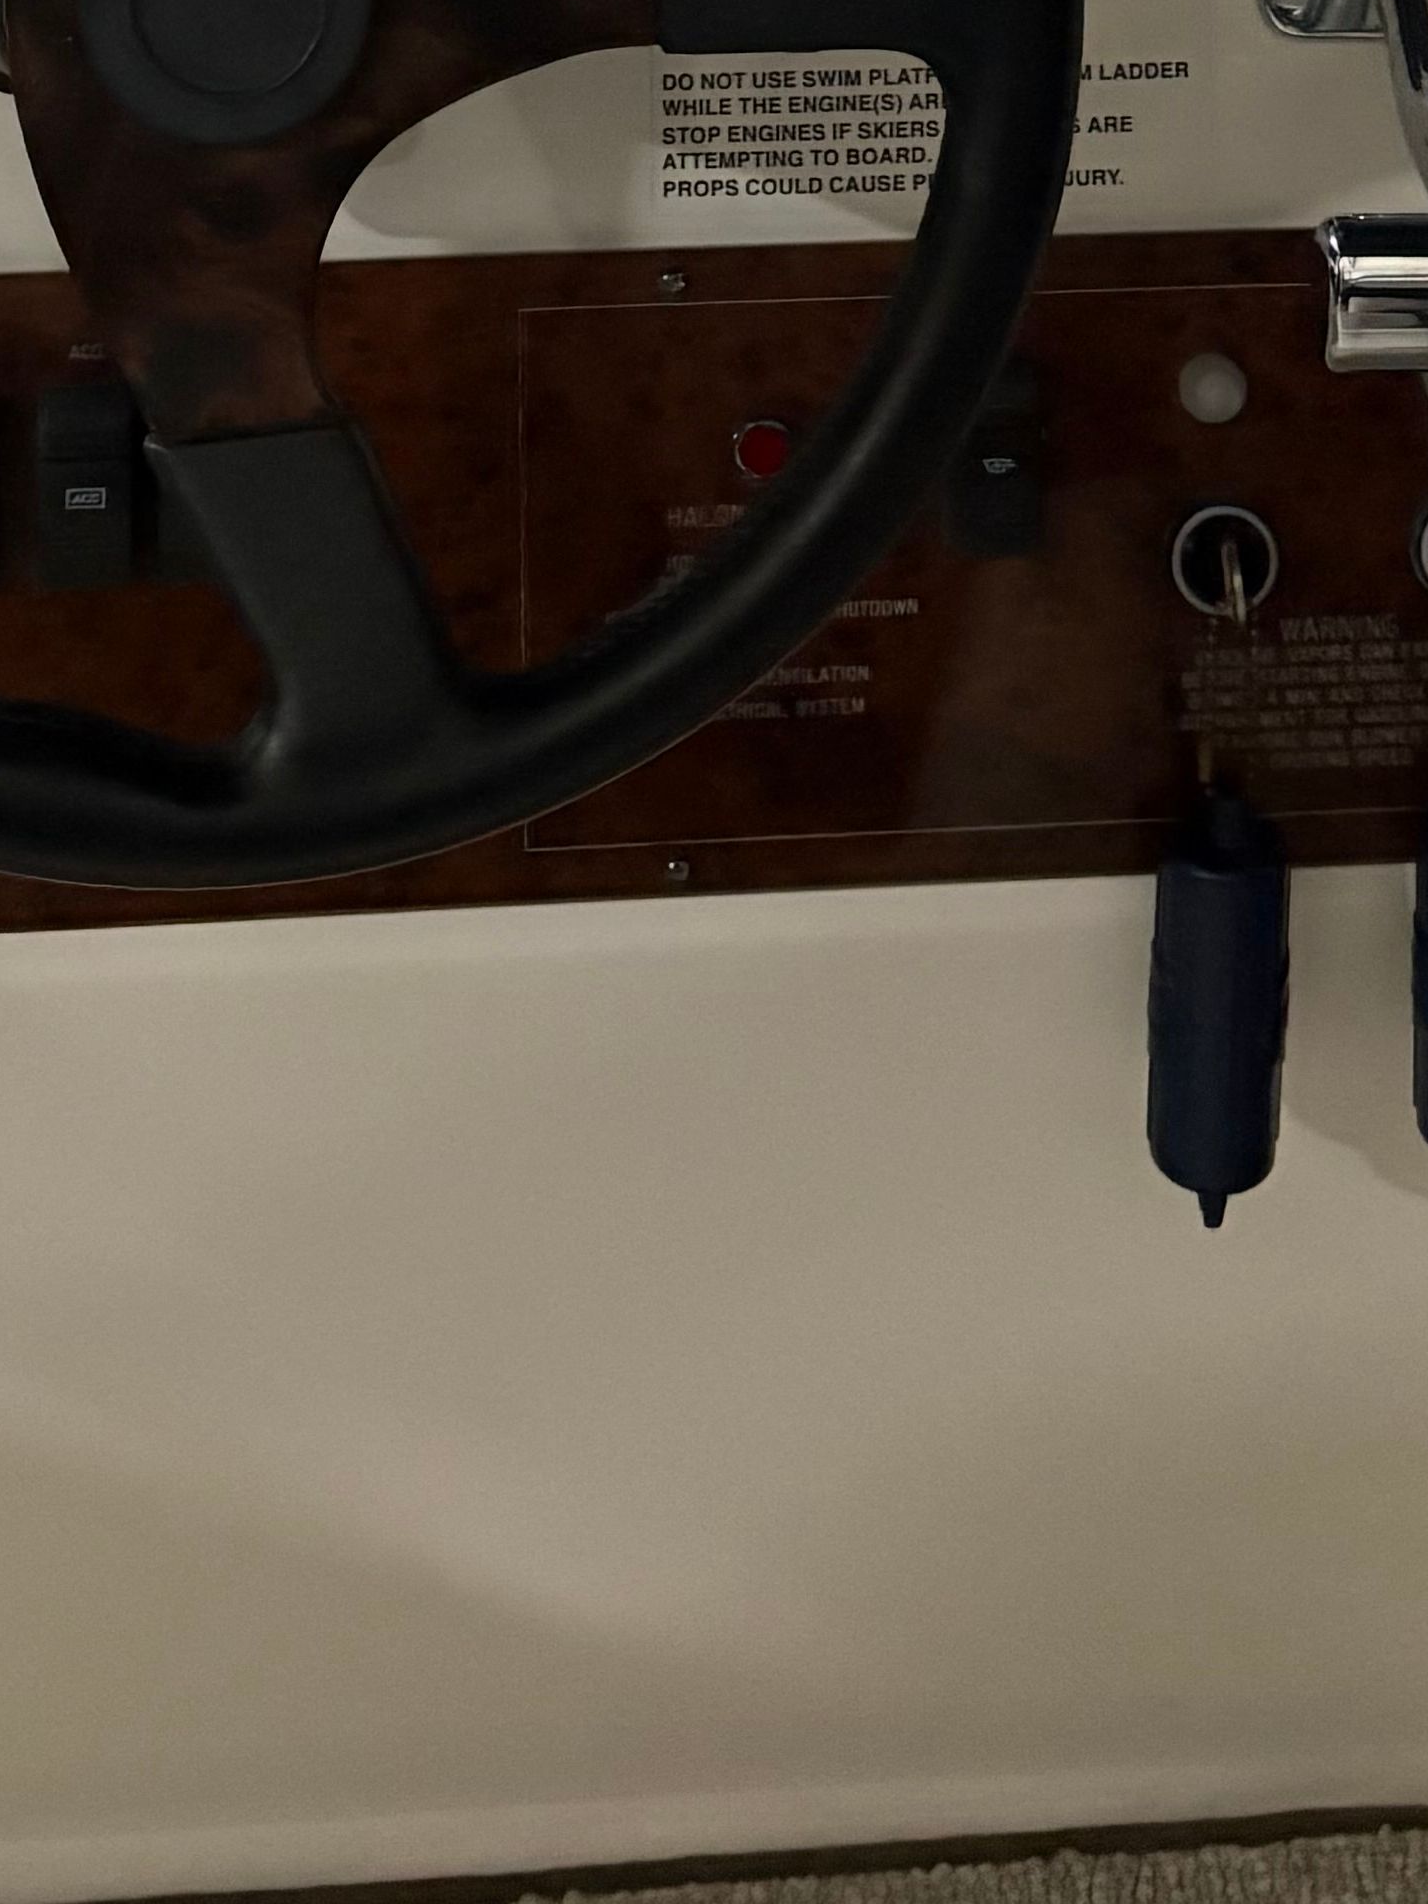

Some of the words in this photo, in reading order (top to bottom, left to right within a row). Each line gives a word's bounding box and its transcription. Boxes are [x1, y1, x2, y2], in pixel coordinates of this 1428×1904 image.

[663, 73, 694, 91] DO
[700, 71, 747, 90] NOT
[753, 70, 798, 89] USE
[802, 68, 863, 88] SWIM
[869, 66, 938, 86] PLATF
[1099, 62, 1190, 81] LADDER
[663, 97, 733, 117] WHILE
[739, 96, 783, 114] THE
[788, 93, 904, 116] ENGINE(S)
[663, 126, 721, 145] STOP
[728, 123, 826, 143] ENGINES
[832, 123, 853, 141] IF
[858, 120, 941, 140] SKIERS
[1088, 115, 1134, 134] ARE
[663, 150, 804, 170] ATTEMPTING
[810, 148, 840, 167] TO
[847, 147, 933, 166] BOARD.
[663, 178, 740, 198] PROPS
[746, 177, 823, 196] COULD
[829, 174, 907, 194] CAUSE
[1063, 169, 1126, 187] JURY.
[835, 598, 920, 619] HUTDOWN
